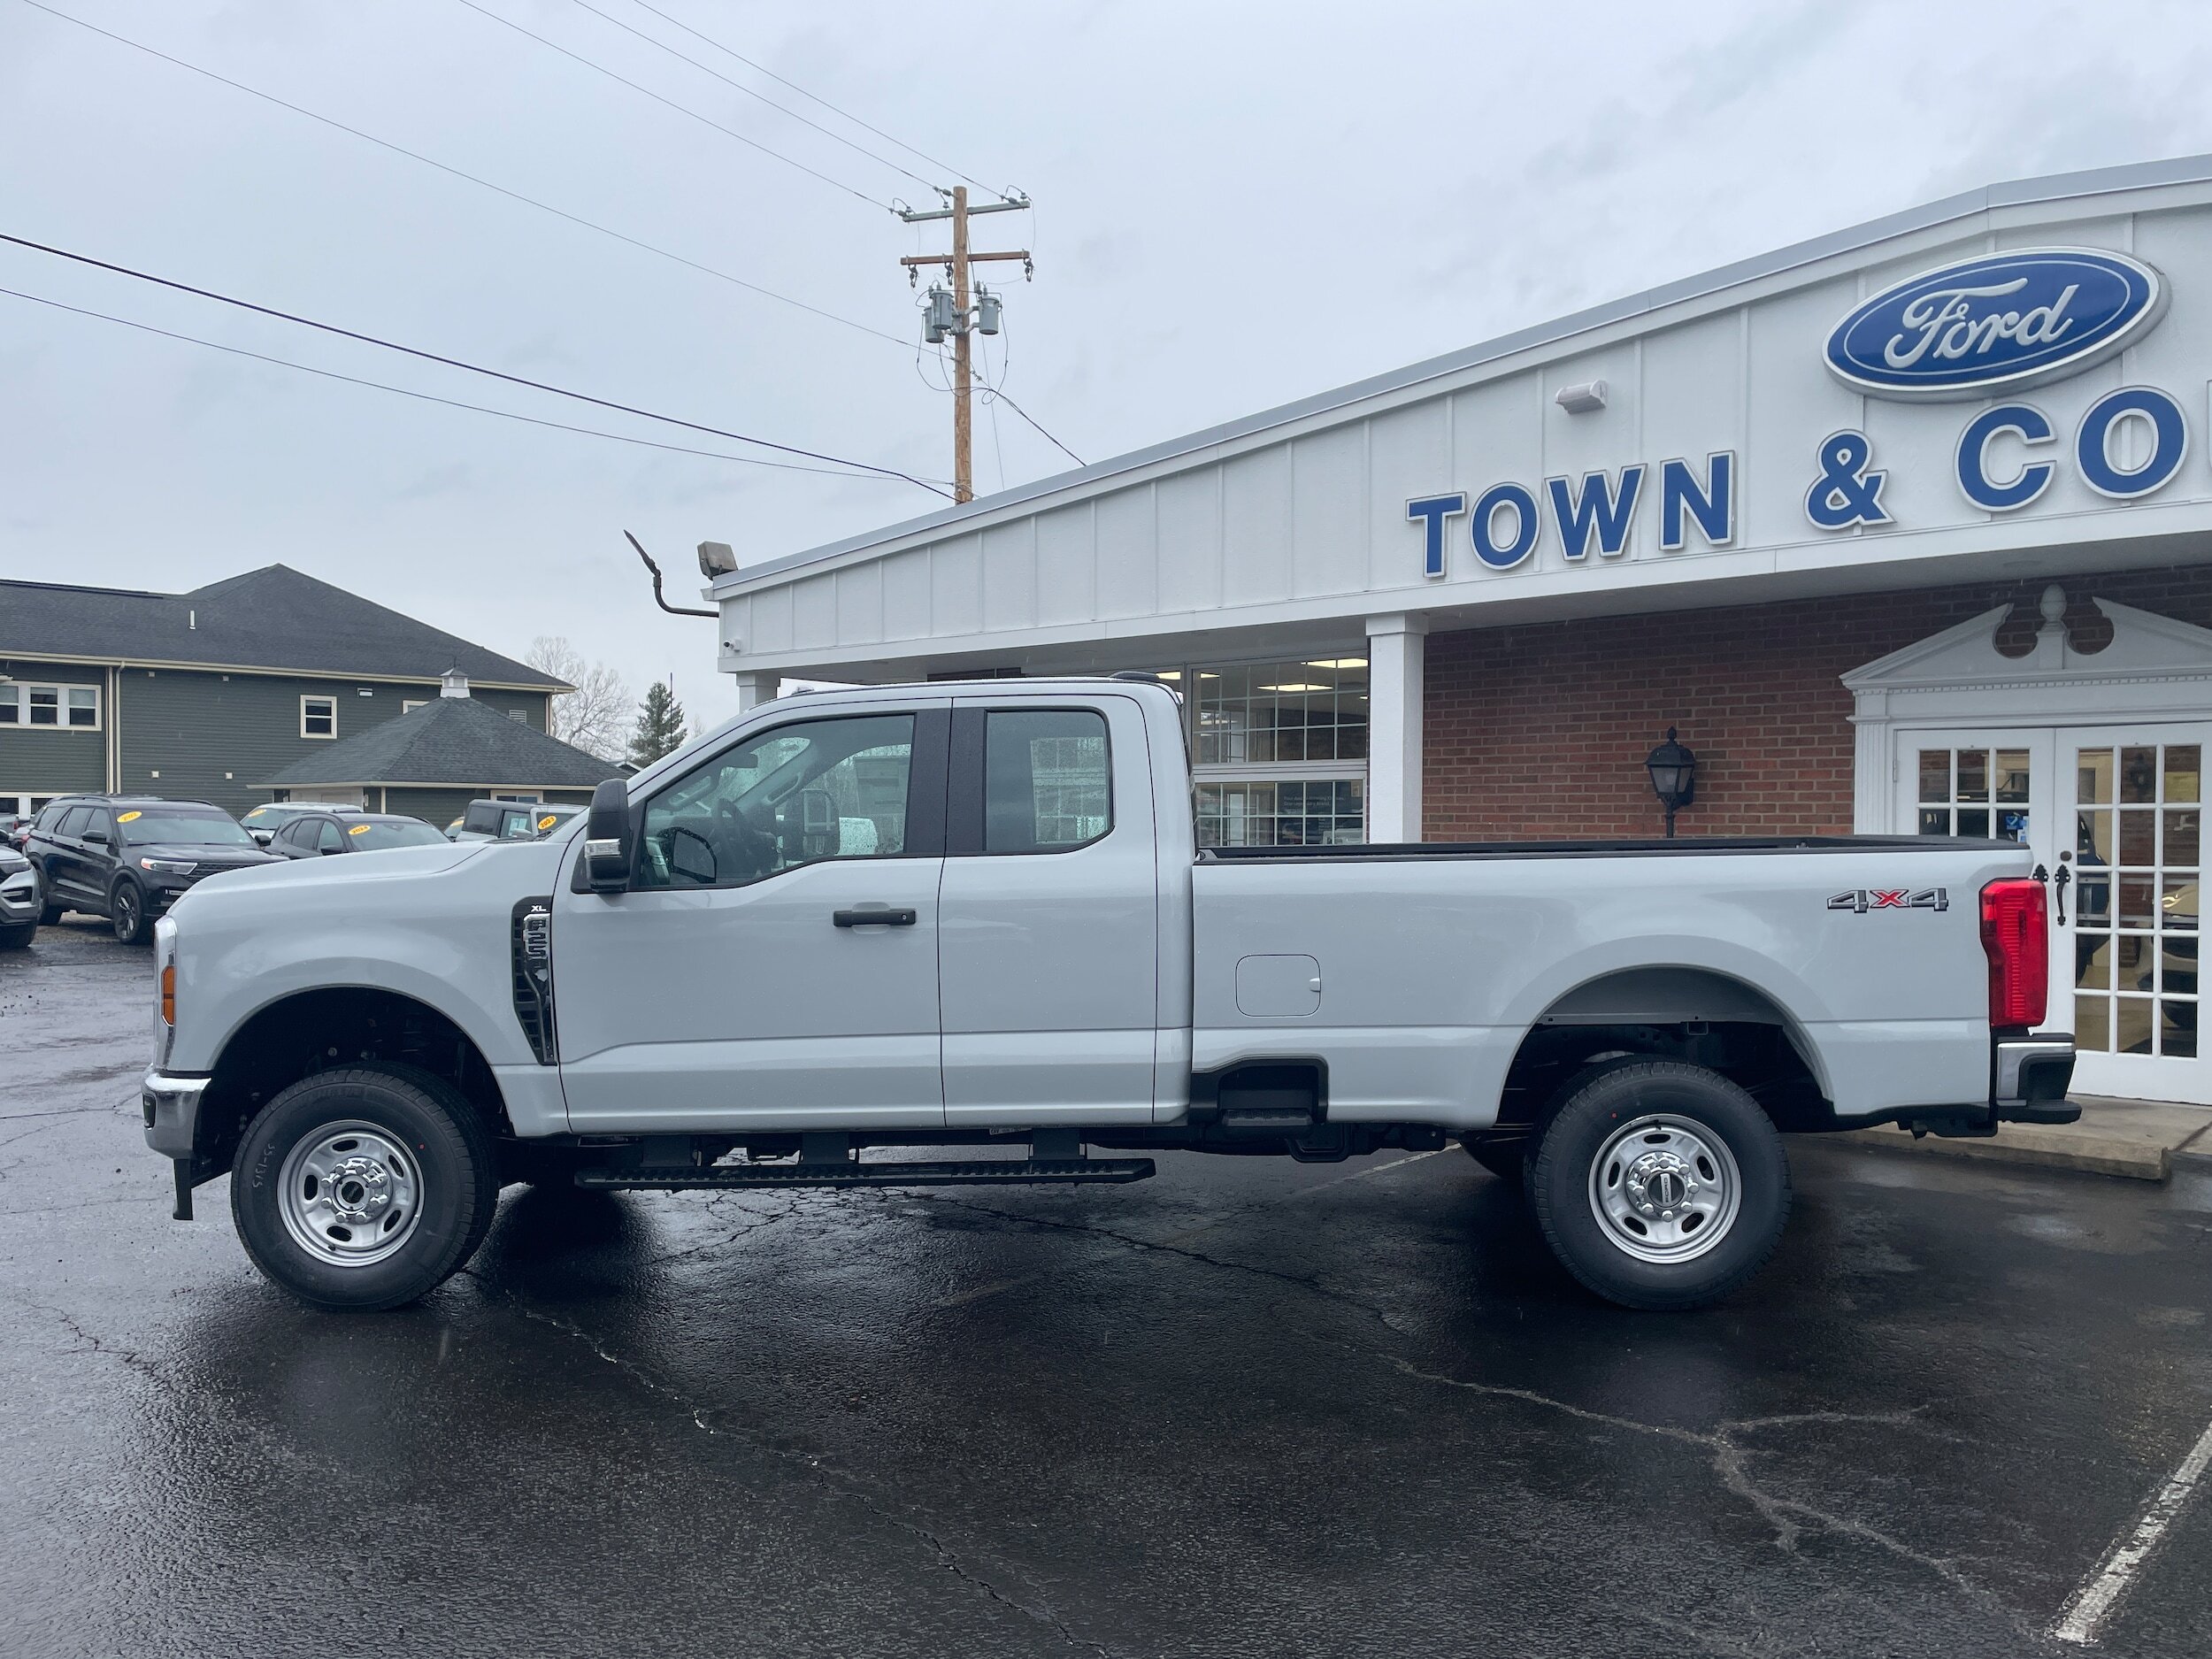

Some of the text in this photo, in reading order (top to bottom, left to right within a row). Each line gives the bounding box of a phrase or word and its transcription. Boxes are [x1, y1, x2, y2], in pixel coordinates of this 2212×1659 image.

[1883, 274, 2081, 370] Ford
[1405, 385, 2212, 578] TOWN & CO
[540, 817, 556, 829] 2023
[1827, 887, 1949, 913] 4X4
